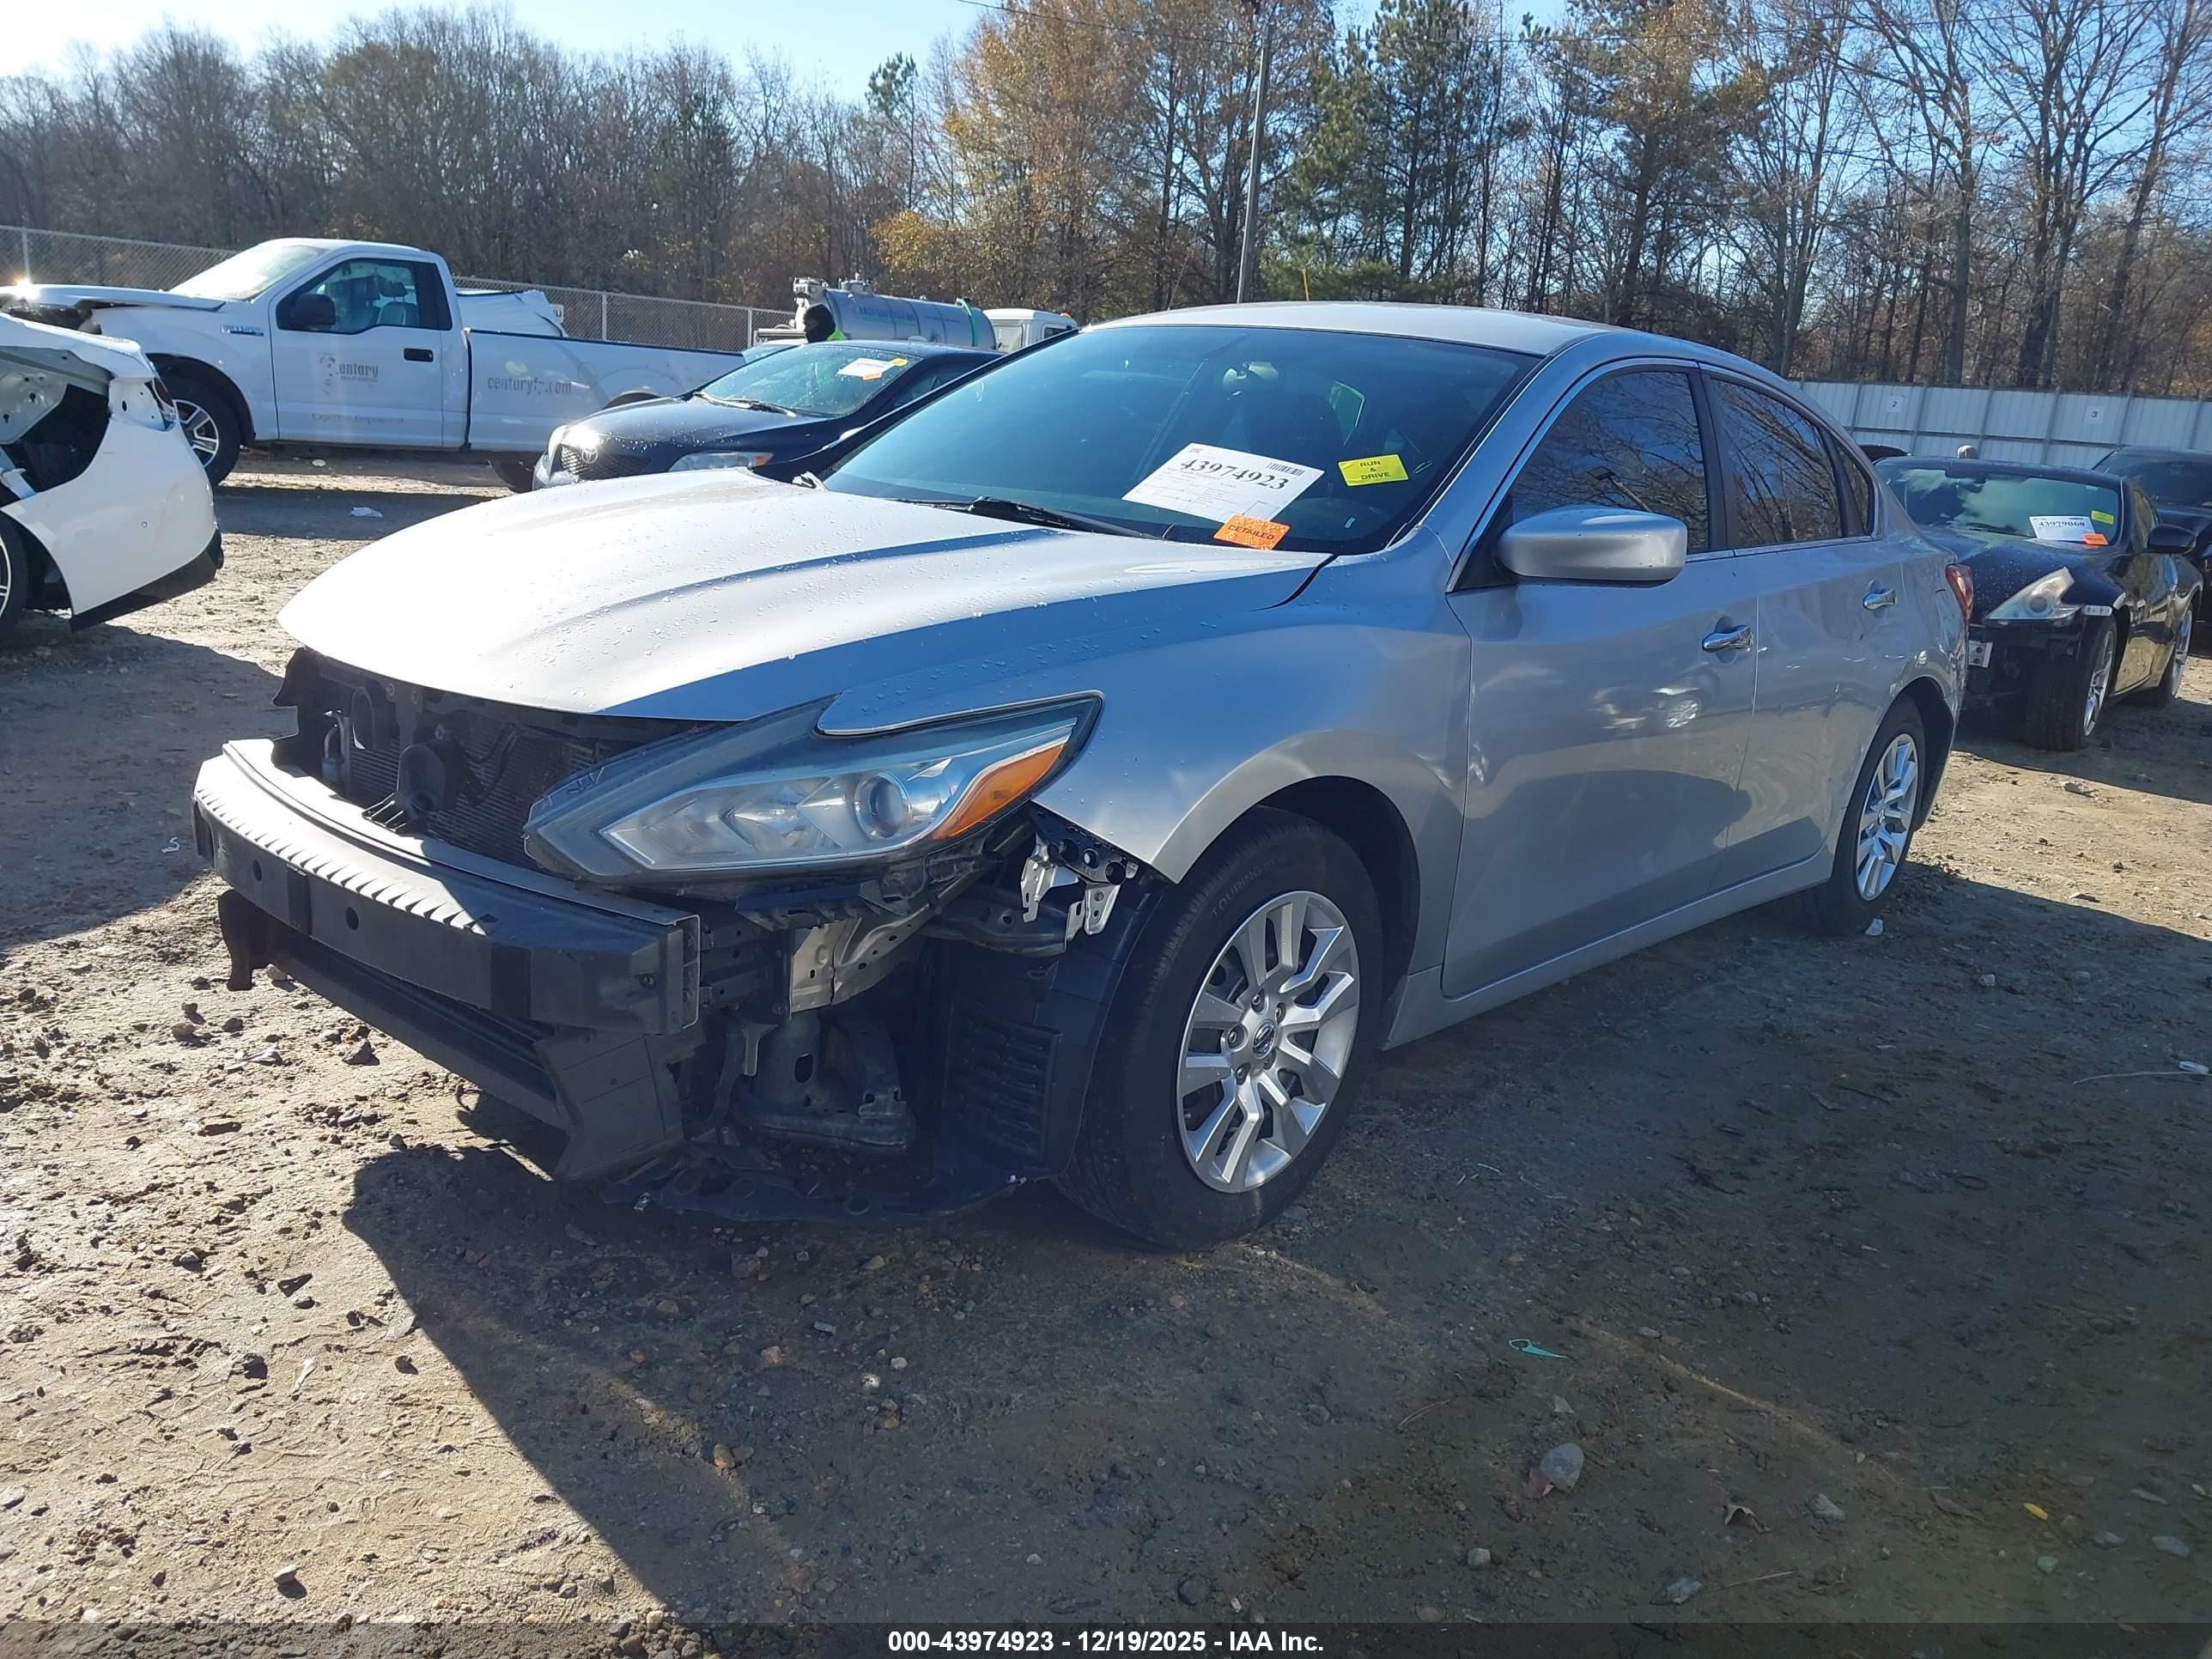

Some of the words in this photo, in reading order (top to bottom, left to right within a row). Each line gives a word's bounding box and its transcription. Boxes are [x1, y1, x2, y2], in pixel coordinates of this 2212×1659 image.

[1181, 459, 1289, 489] 43974923
[1360, 471, 1391, 480] DRIVE
[1228, 524, 1274, 540] DETAILED
[1211, 864, 1263, 917] TOURING
